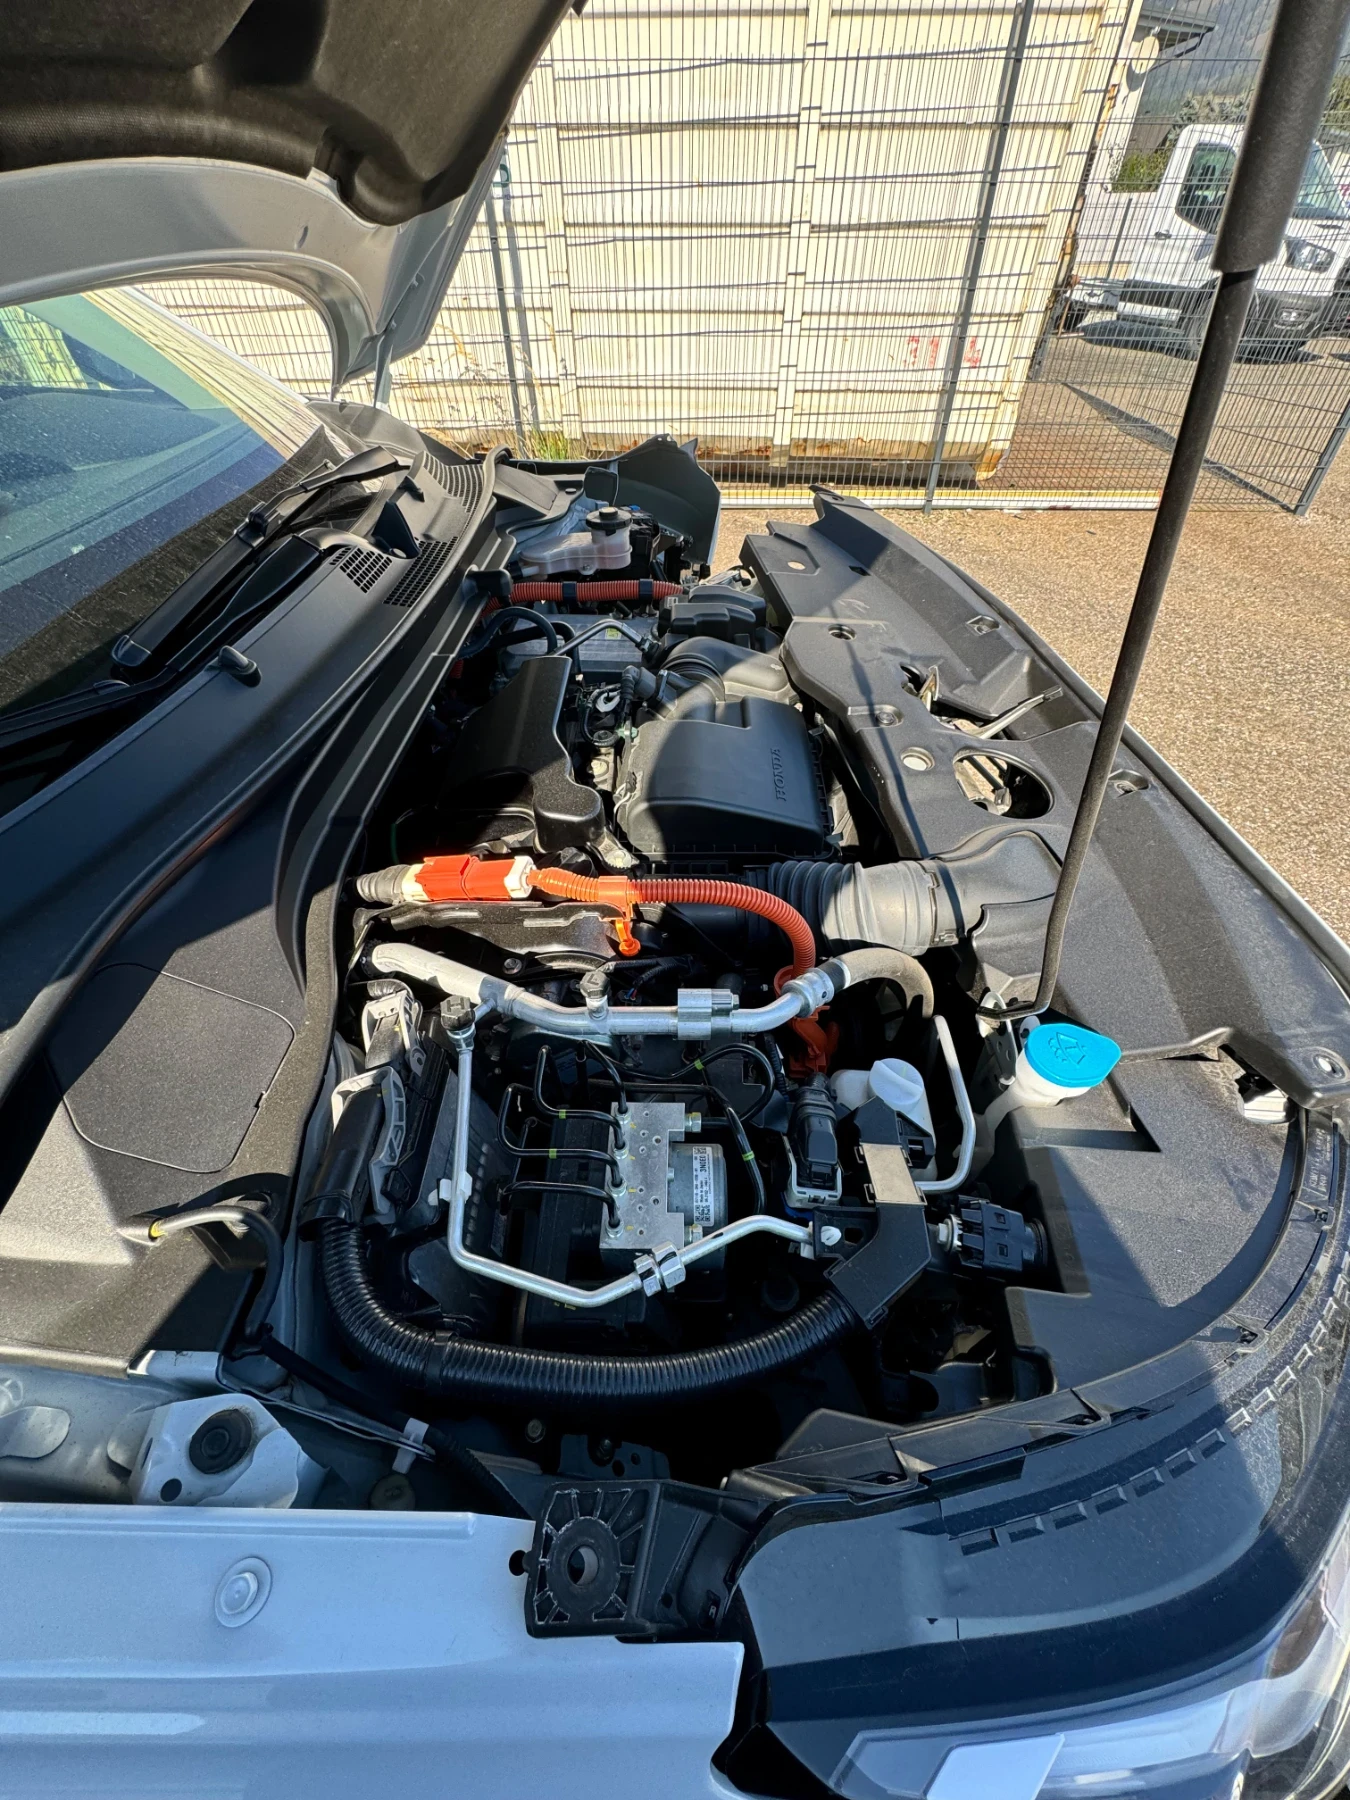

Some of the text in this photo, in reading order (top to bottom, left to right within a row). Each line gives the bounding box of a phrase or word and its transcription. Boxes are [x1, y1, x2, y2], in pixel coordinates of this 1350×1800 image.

[770, 748, 787, 802] HONDA
[587, 973, 600, 986] L
[446, 997, 465, 1013] H
